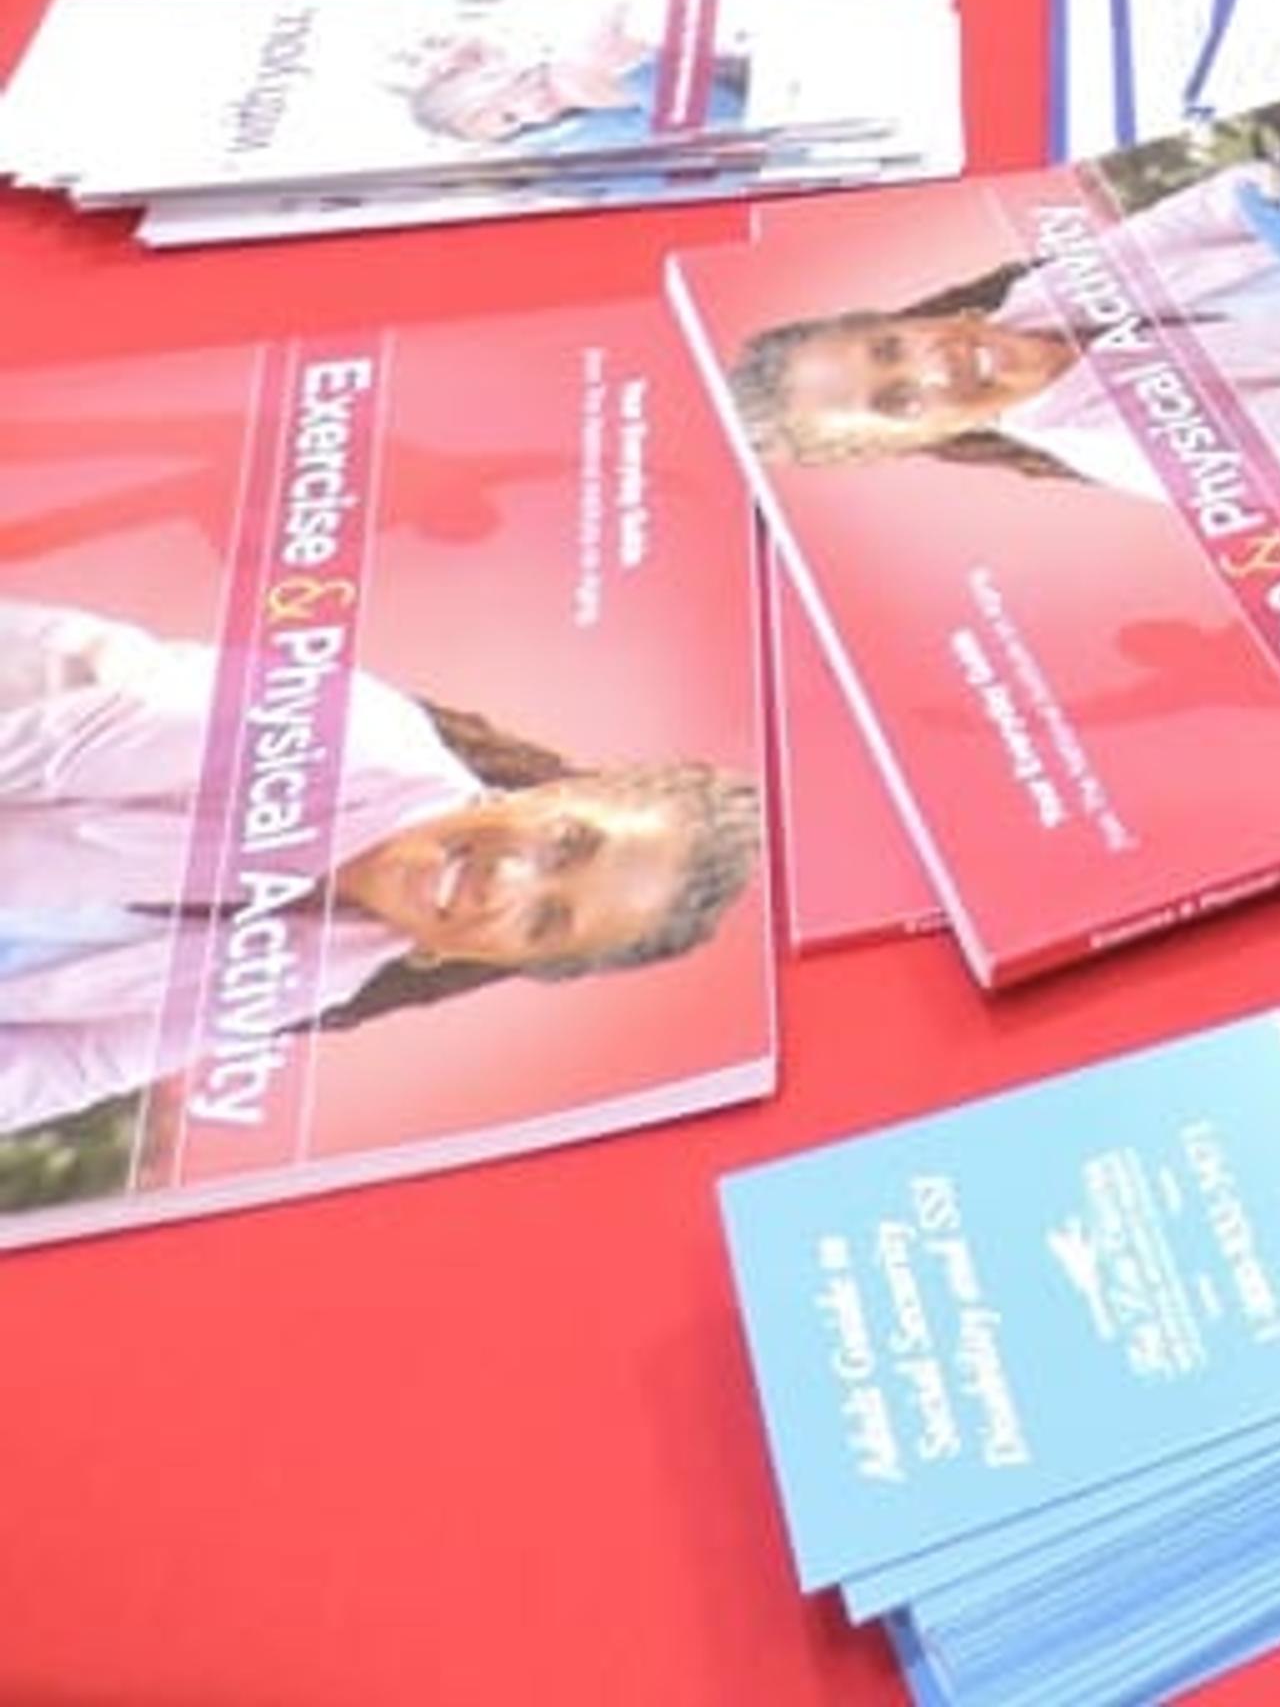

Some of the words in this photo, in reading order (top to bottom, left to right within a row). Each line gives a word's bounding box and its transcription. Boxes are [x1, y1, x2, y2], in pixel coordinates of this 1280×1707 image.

[1036, 206, 1154, 352] Activity
[281, 355, 371, 566] Exercise
[1127, 361, 1265, 538] Physical
[267, 578, 356, 623] &
[242, 625, 346, 854] Physical
[188, 870, 317, 1125] Activity
[911, 1175, 961, 1230] SSI
[926, 1235, 981, 1303] and
[875, 1220, 932, 1355] Security
[893, 1357, 961, 1460] Social
[956, 1307, 1030, 1468] Disability
